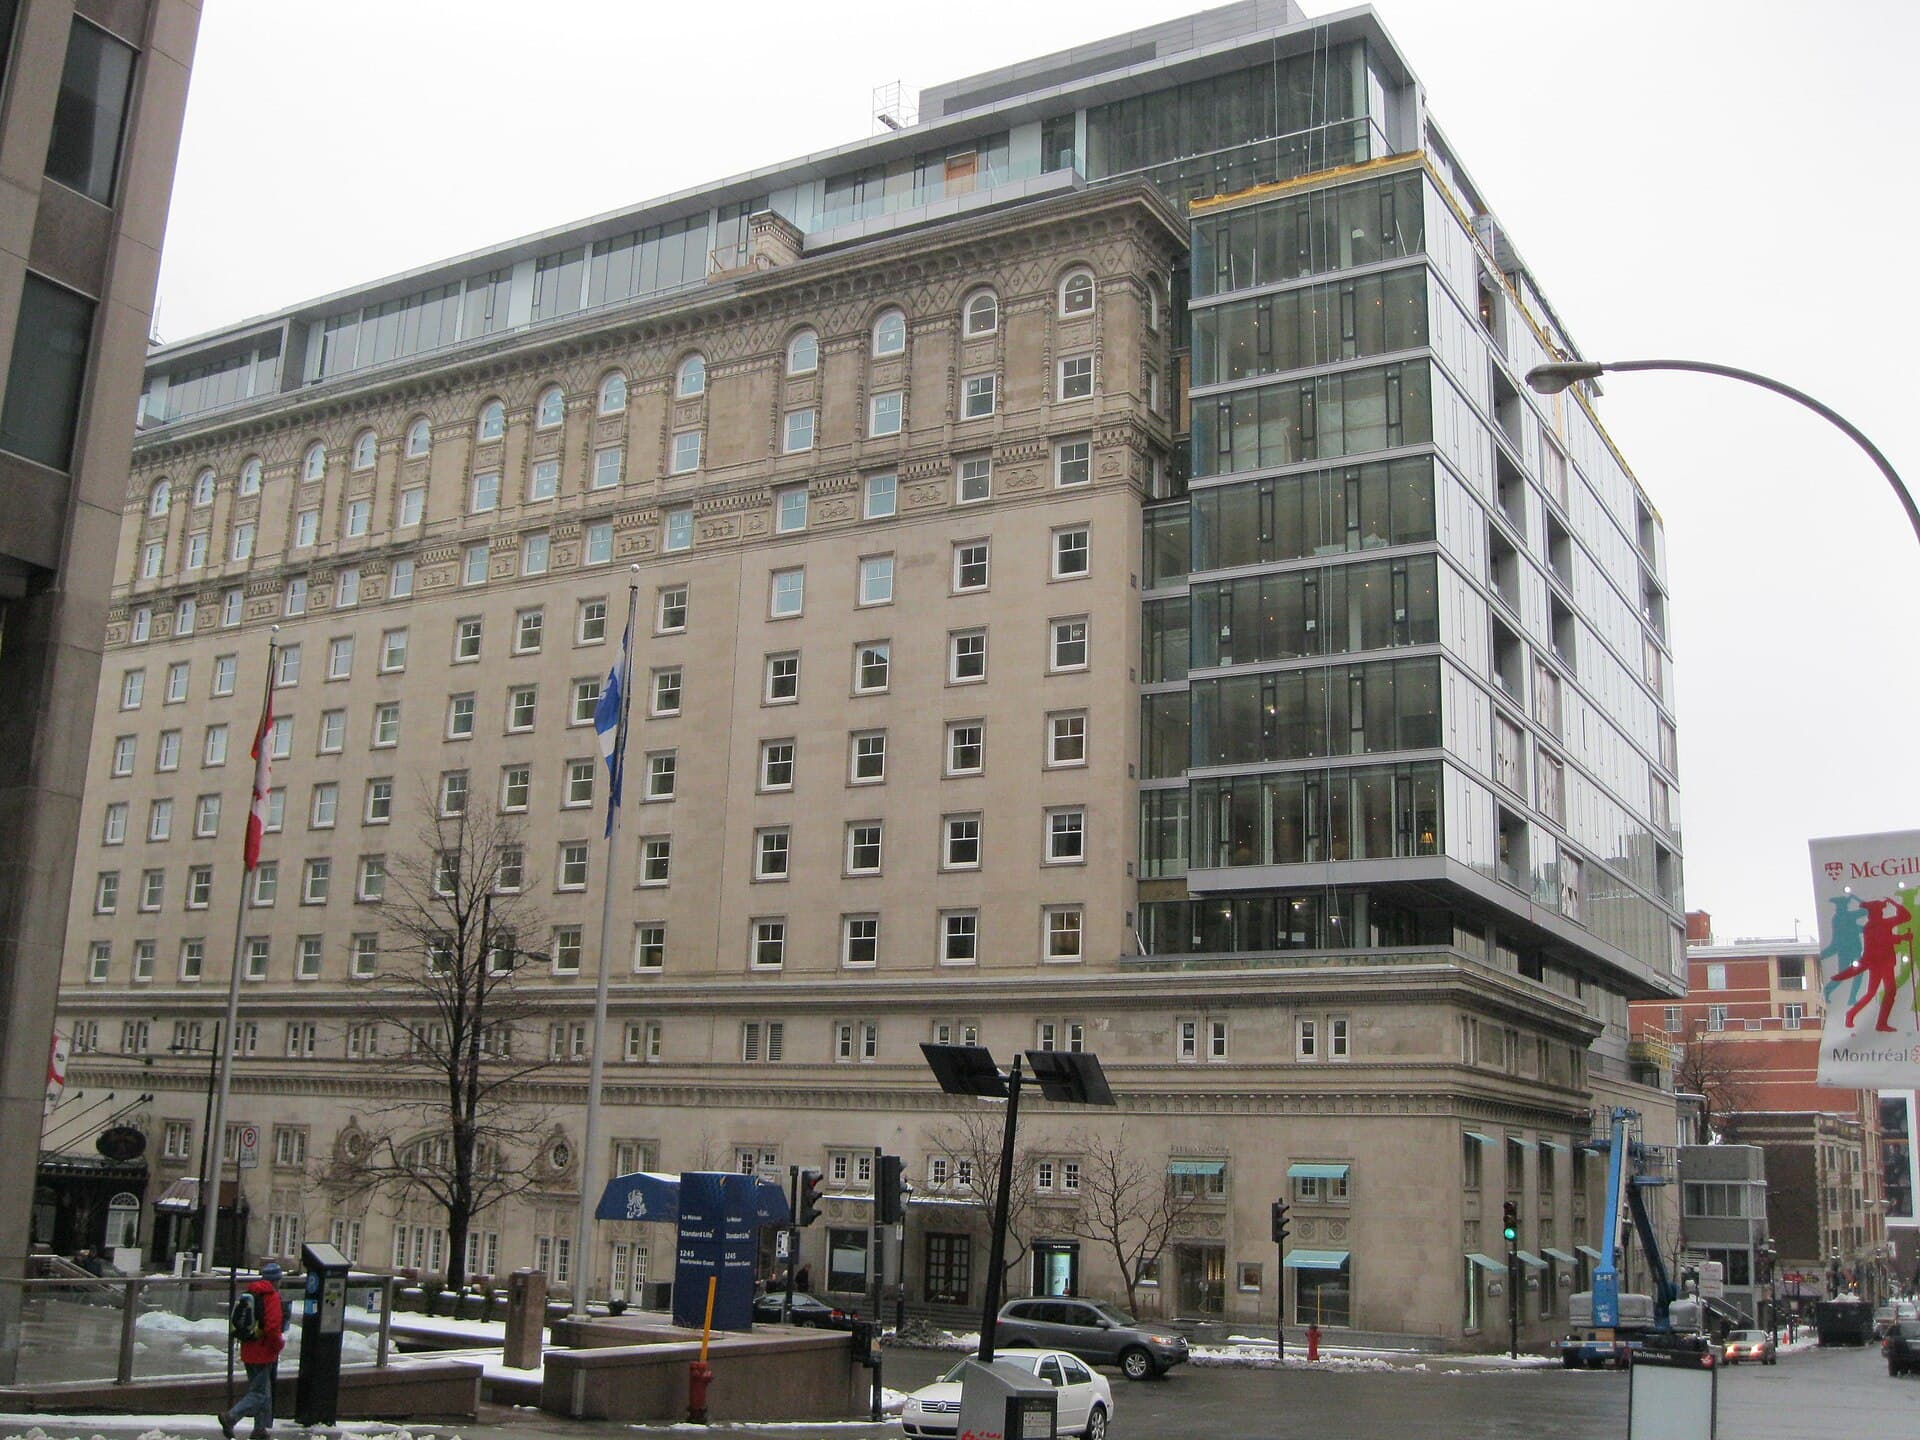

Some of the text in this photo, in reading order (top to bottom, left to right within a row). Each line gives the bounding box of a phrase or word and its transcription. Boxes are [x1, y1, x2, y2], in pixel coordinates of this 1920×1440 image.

[1850, 857, 1920, 879] McGill
[1832, 1047, 1908, 1063] Montréal
[681, 1230, 702, 1238] Standard
